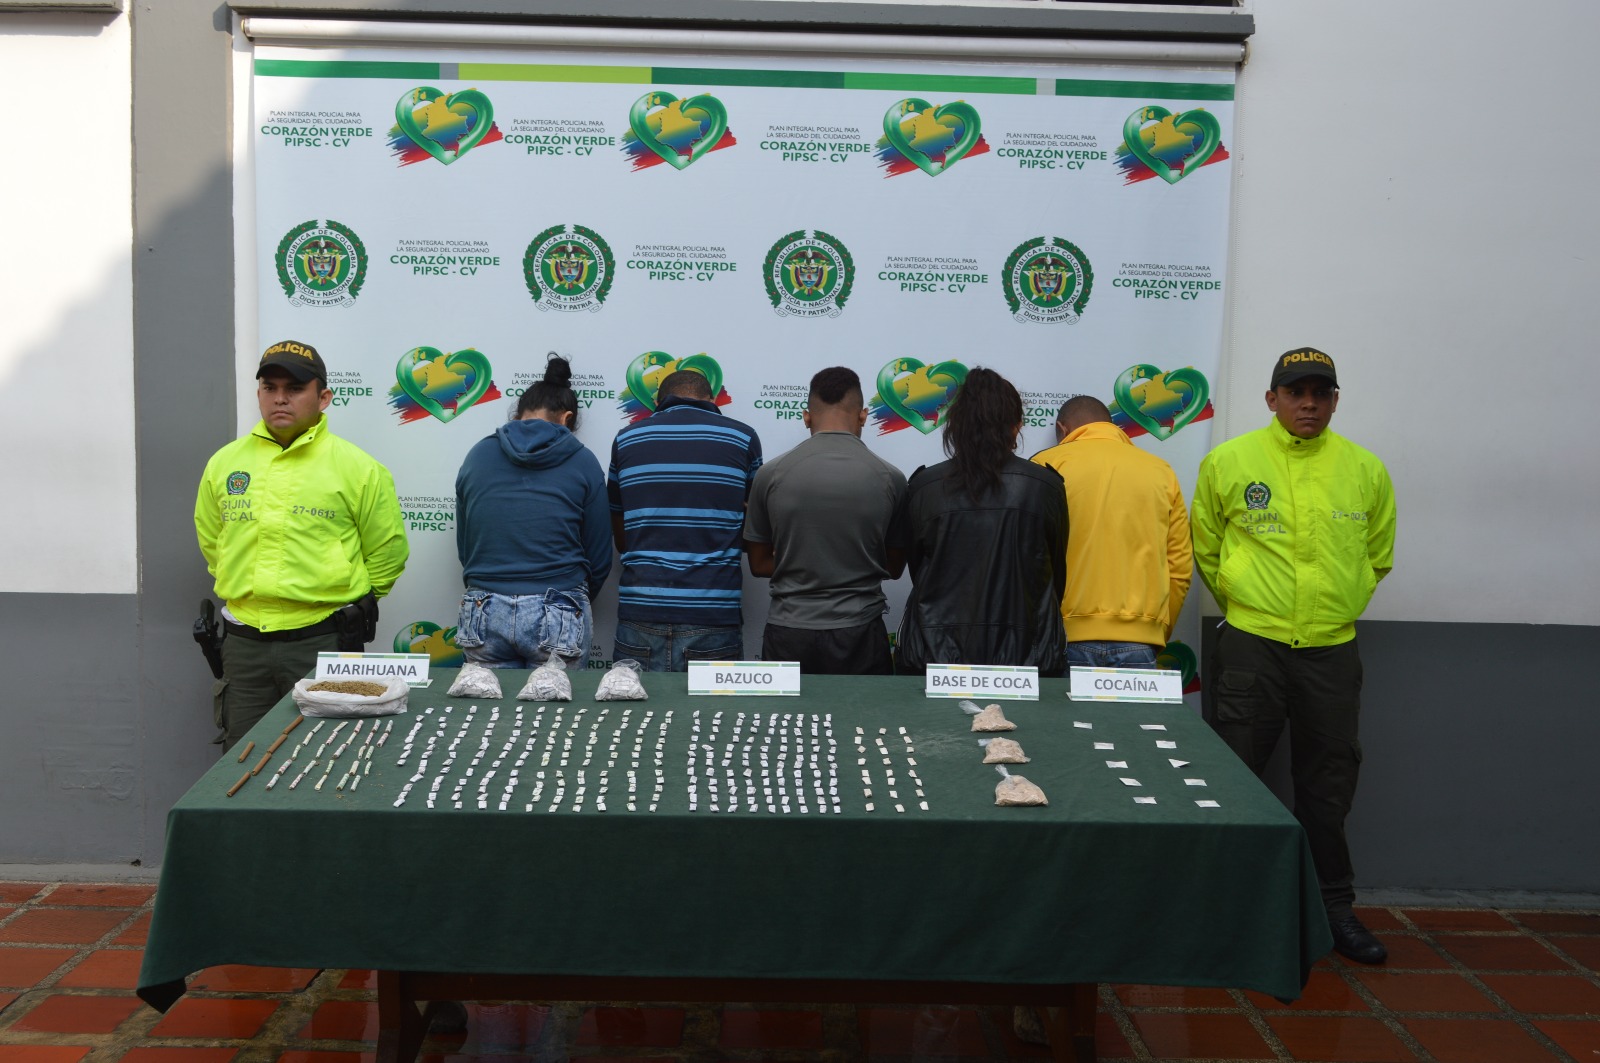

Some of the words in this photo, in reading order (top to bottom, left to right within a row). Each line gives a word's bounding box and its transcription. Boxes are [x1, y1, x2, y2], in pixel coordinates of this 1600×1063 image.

[261, 125, 328, 136] CORAZÓN
[331, 128, 372, 136] VERDE
[285, 138, 321, 147] PIPSC
[333, 138, 350, 147] CV
[504, 133, 571, 144] CORAZÓN
[574, 136, 615, 146] VERDE
[528, 146, 563, 155] PIPSC
[575, 147, 592, 156] CV
[760, 140, 826, 151] CORAZÓN
[829, 143, 870, 152] VERDE
[783, 152, 818, 162] PIPSC
[830, 154, 848, 162] CV
[997, 147, 1063, 159] CORAZÓN
[1066, 150, 1107, 160] VERDE
[1020, 160, 1055, 169] PIPSC
[1067, 161, 1084, 170] CV
[335, 234, 356, 269] COLOMBIA
[582, 238, 603, 274] COLOMBIA
[390, 254, 456, 264] CORAZÓN
[458, 256, 500, 266] VERDE
[627, 259, 692, 270] CORAZÓN
[695, 262, 736, 271] VERDE
[822, 244, 843, 279] COLOMBIA
[414, 266, 448, 275] PIPSC
[460, 267, 477, 275] CV
[1061, 251, 1082, 286] COLOMBIA
[650, 271, 685, 280] PIPSC
[696, 272, 714, 281] CV
[878, 270, 944, 282] CORAZÓN
[947, 274, 988, 283] VERDE
[323, 276, 353, 297] NACIONAL
[901, 283, 936, 292] PIPSC
[948, 284, 966, 293] CV
[1113, 278, 1177, 289] CORAZÓN
[1180, 281, 1221, 290] VERDE
[569, 281, 601, 302] NACIONAL
[809, 287, 840, 307] NACIONAL
[1135, 290, 1170, 299] PIPSC
[1181, 291, 1198, 300] CV
[299, 294, 315, 305] DIOS
[322, 295, 346, 305] PATRIA
[546, 299, 562, 309] DIOS
[569, 300, 593, 310] PATRIA
[1047, 294, 1079, 314] NACIONAL
[785, 305, 802, 315] DIOS
[808, 306, 832, 315] PATRIA
[1024, 311, 1040, 321] DIOS
[1047, 312, 1070, 322] PATRIA
[264, 343, 313, 360] POLICIA
[1283, 352, 1333, 368] POLICIA
[330, 387, 372, 396] VERDE
[574, 390, 614, 399] VERDE
[332, 398, 350, 406] CV
[222, 500, 251, 509] SIJIN
[222, 512, 257, 522] ECAL
[292, 506, 335, 519] 27-0613
[1242, 512, 1278, 522] SIJIN
[411, 522, 446, 531] PIPSC
[1243, 524, 1286, 534] ECAL
[327, 664, 417, 676] MARIHUANA
[716, 673, 772, 684] BAZUCO
[932, 676, 966, 686] BASE
[972, 677, 989, 687] DE
[994, 677, 1032, 689] COCA
[1094, 677, 1158, 692] COCAÍNA
